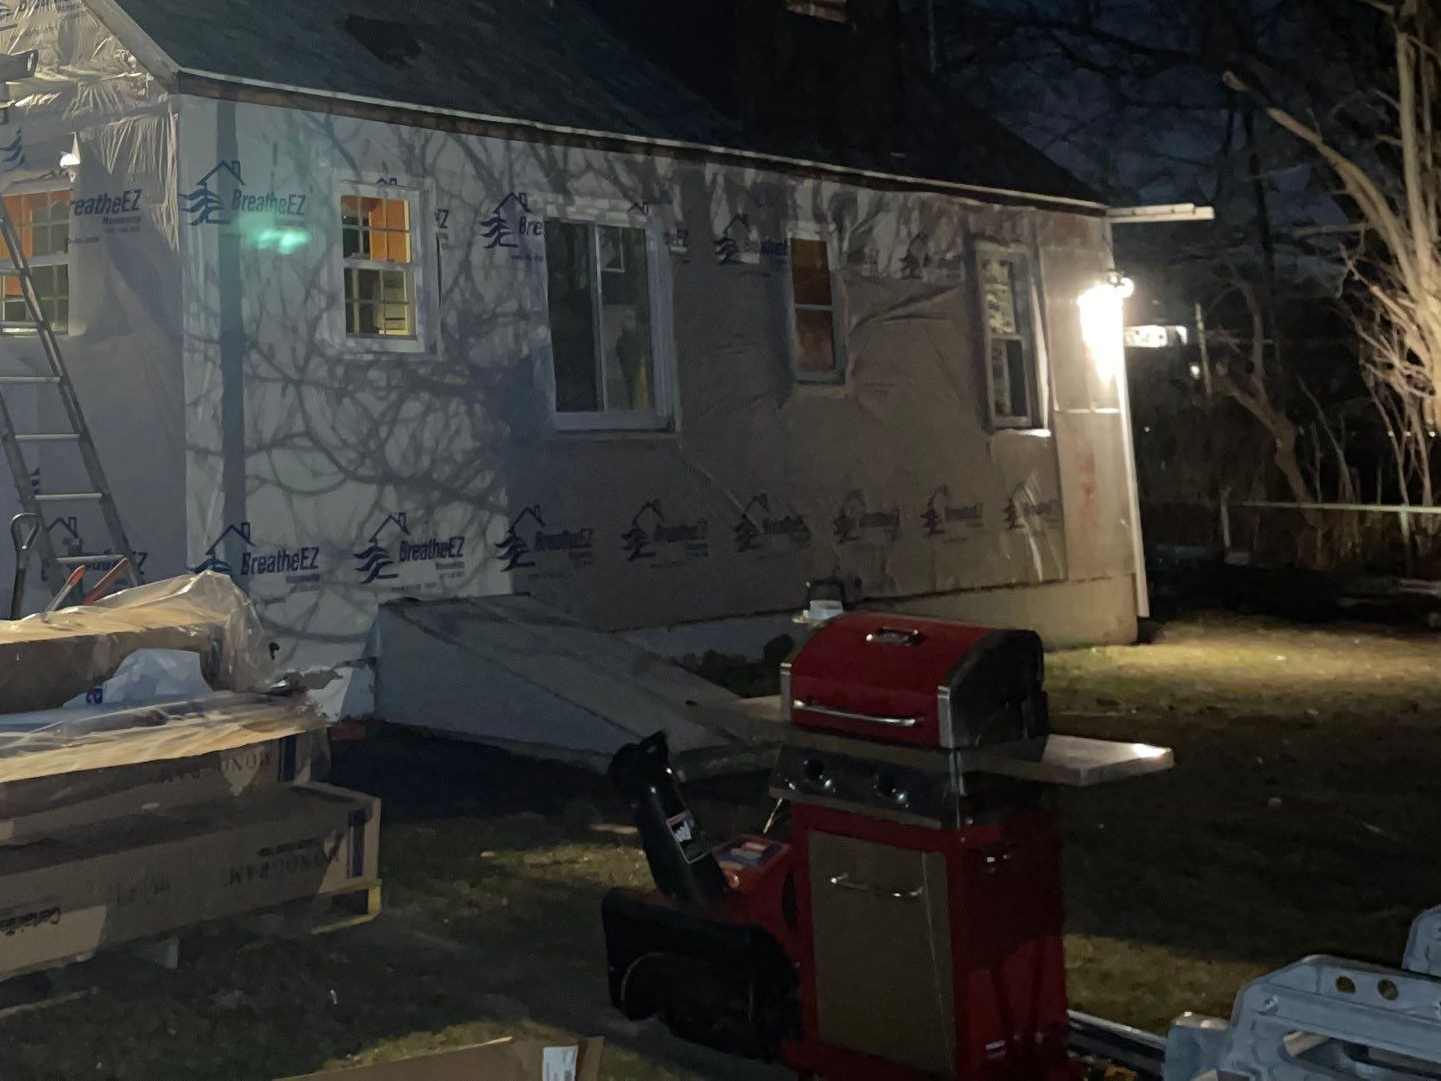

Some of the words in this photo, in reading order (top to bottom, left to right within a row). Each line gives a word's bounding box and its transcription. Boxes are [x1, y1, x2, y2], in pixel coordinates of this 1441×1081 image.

[231, 189, 307, 216] BreatheEZ
[240, 546, 320, 576] BreatheEZ
[399, 535, 465, 563] BreatheEZ
